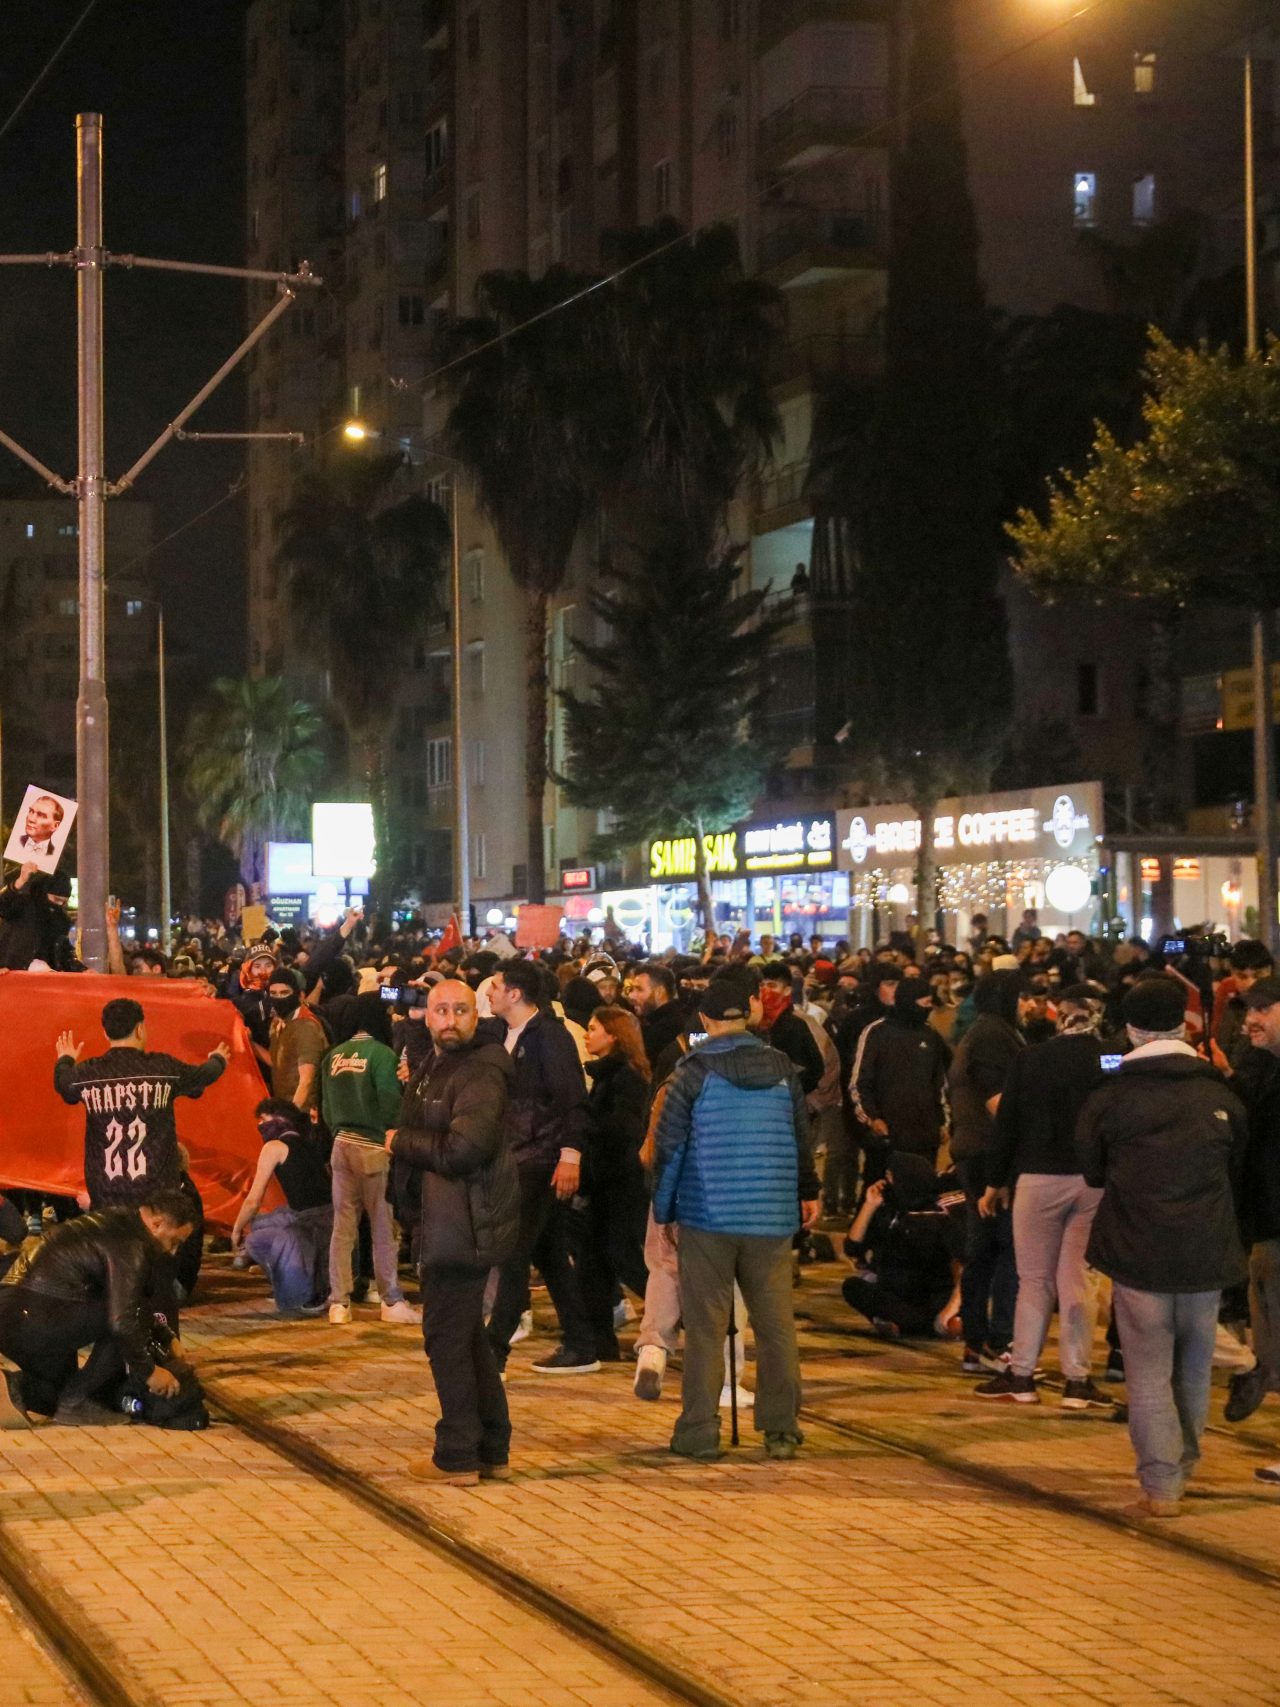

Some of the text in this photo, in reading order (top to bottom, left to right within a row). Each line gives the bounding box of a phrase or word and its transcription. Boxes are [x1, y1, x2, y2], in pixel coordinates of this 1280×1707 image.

[958, 807, 1037, 846] COFFEE
[81, 1081, 172, 1114] TRAPSTAR
[104, 1114, 147, 1181] 22
